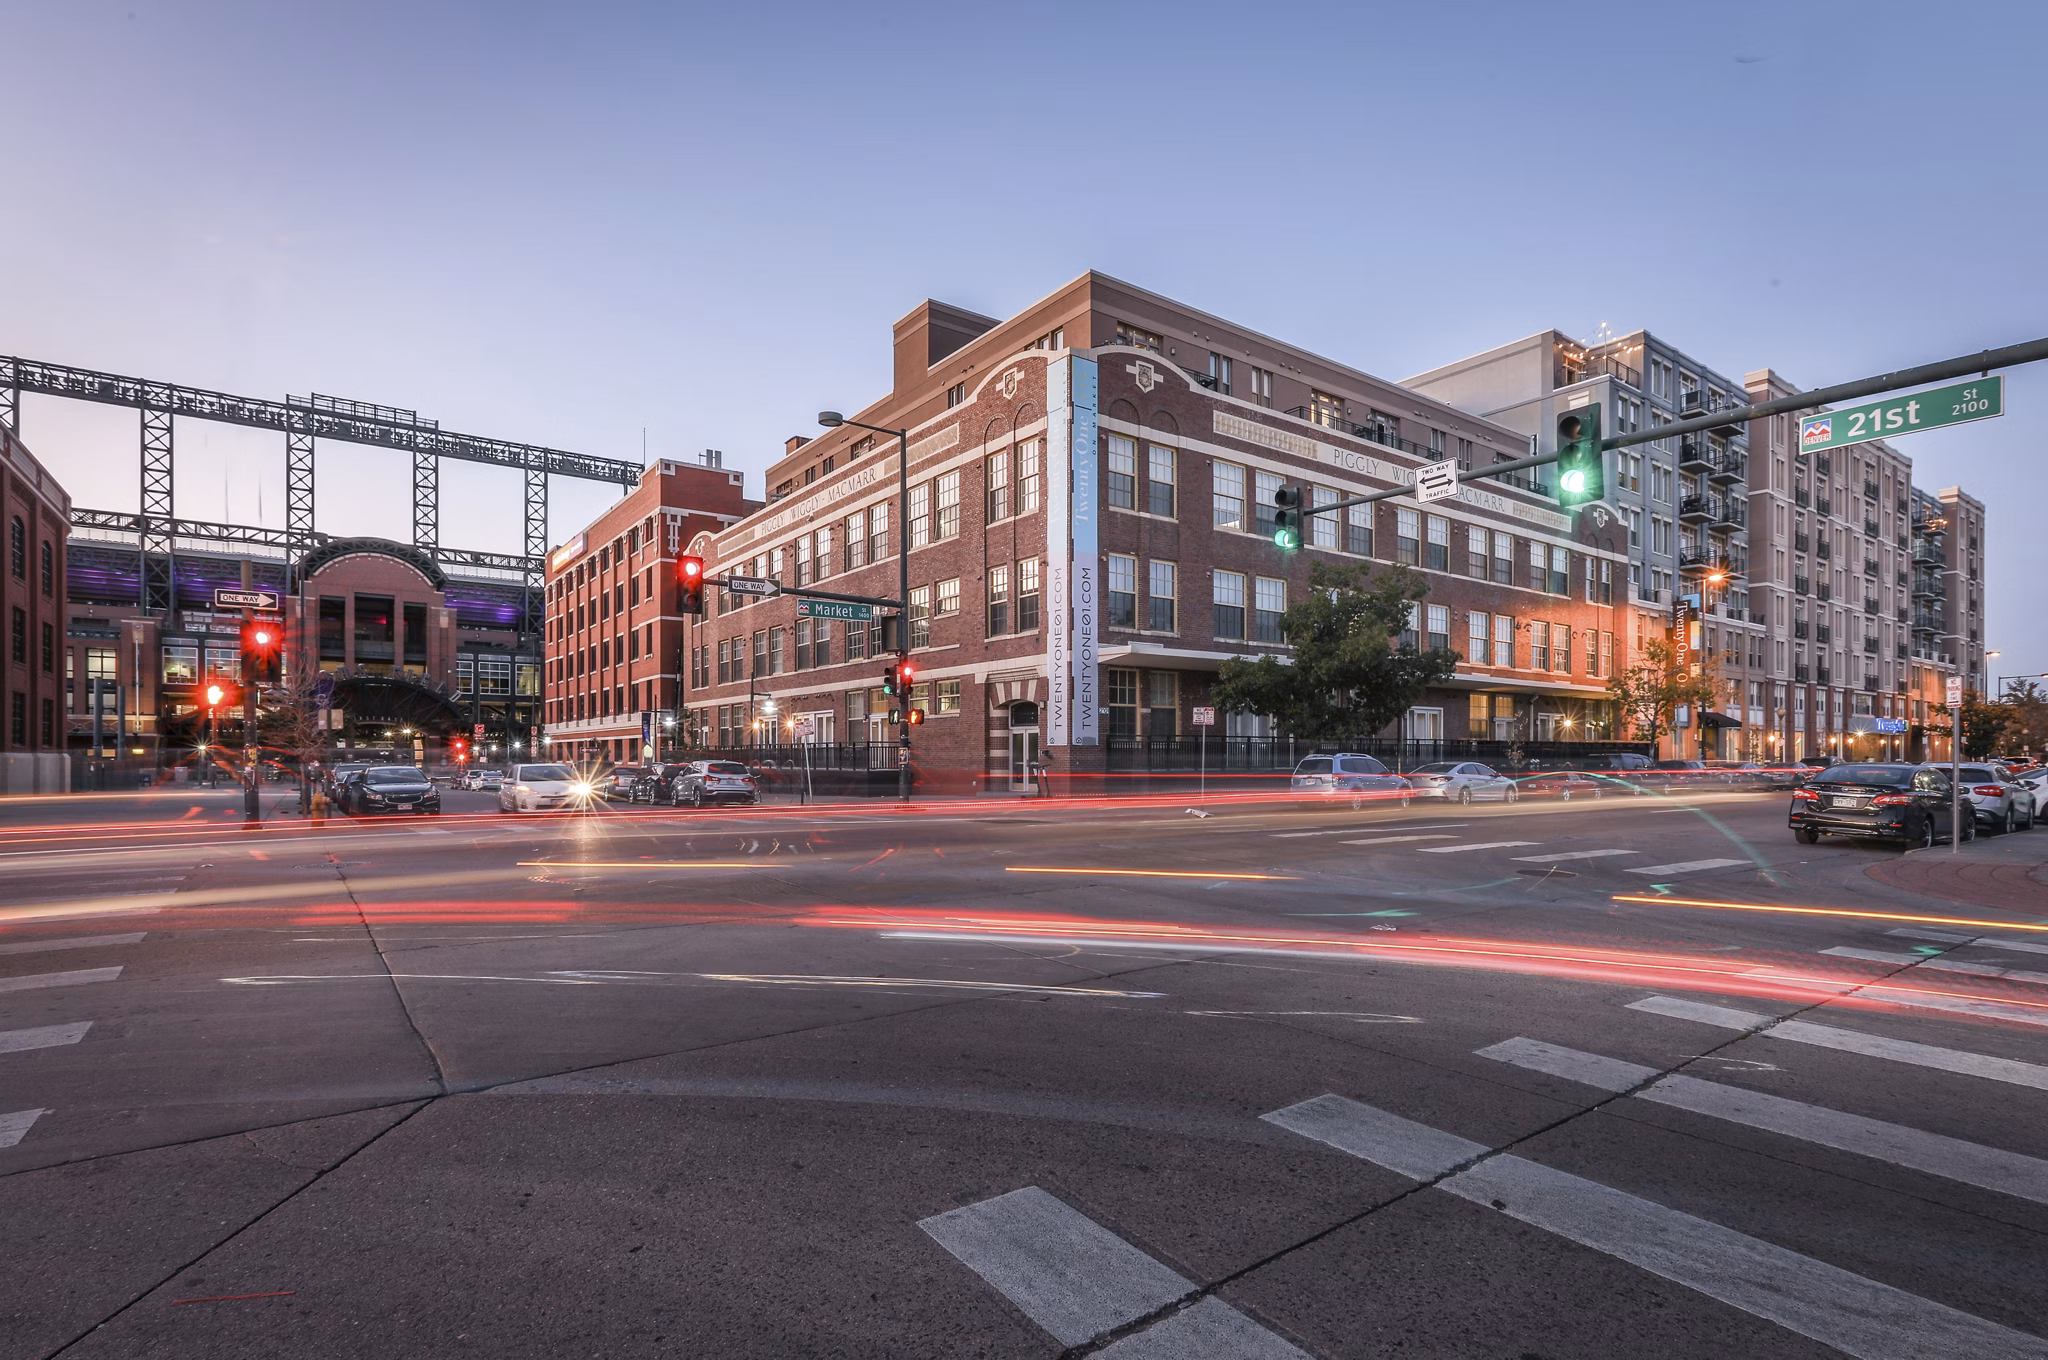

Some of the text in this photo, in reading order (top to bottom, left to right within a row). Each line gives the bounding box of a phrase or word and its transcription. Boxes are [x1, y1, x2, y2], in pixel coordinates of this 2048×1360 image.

[1963, 387, 1978, 401] St
[1951, 399, 1989, 416] 2100
[1847, 400, 1921, 438] 21st
[1804, 433, 1832, 445] DENVER
[1091, 440, 1097, 456] ON
[1075, 416, 1089, 526] TwentyOne
[1421, 463, 1450, 476] TWO WAY
[1333, 448, 1381, 476] PIGGLY
[1455, 486, 1505, 512] ACMARR
[1425, 488, 1450, 499] TRAFFIC
[761, 512, 785, 536] PIGGLY
[790, 496, 821, 519] WIGGLY
[828, 467, 877, 502] MACMARR
[733, 581, 766, 591] ONE WAY
[222, 594, 259, 603] ONE WAY
[815, 603, 853, 618] Market
[1673, 601, 1689, 666] TwentyOne
